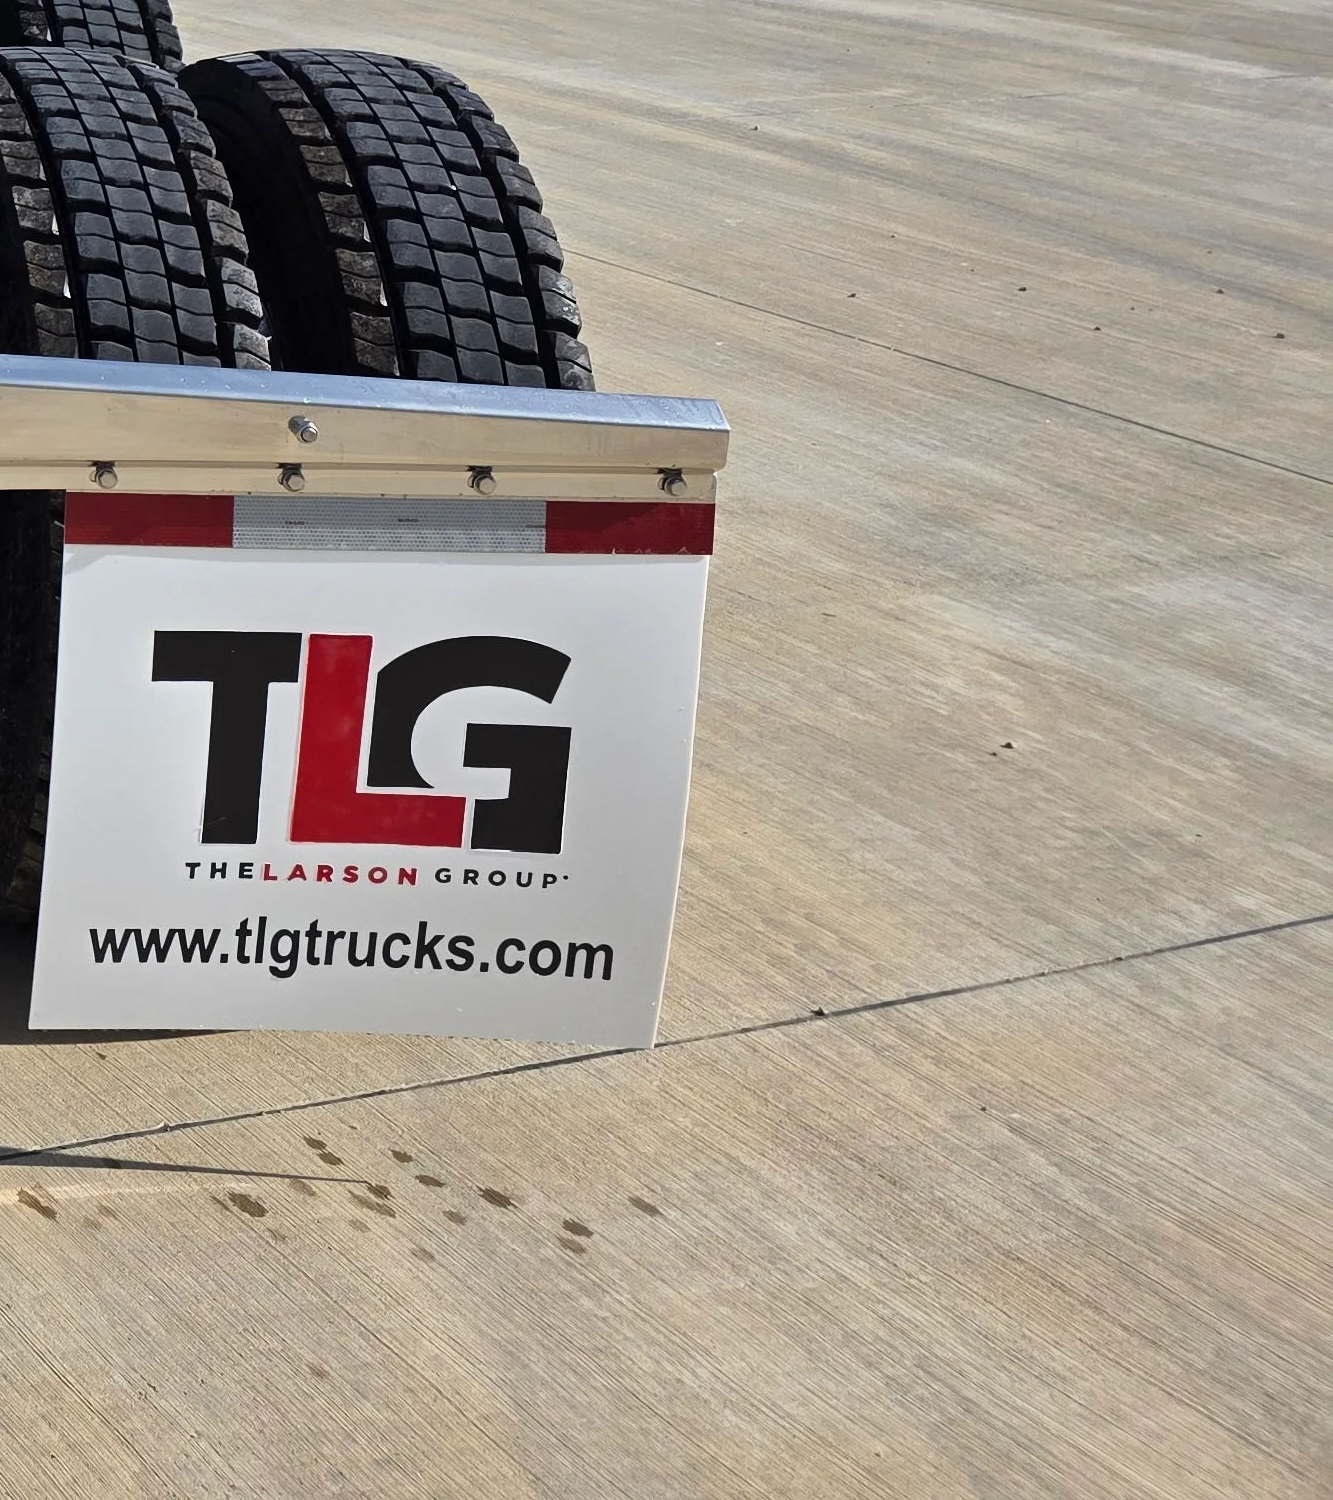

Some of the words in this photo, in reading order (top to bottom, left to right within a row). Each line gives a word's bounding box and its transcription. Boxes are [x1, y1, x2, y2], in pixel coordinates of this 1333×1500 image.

[151, 629, 573, 855] TLG
[434, 867, 559, 890] GROUP
[88, 915, 615, 981] www.tlgtrucks.com
